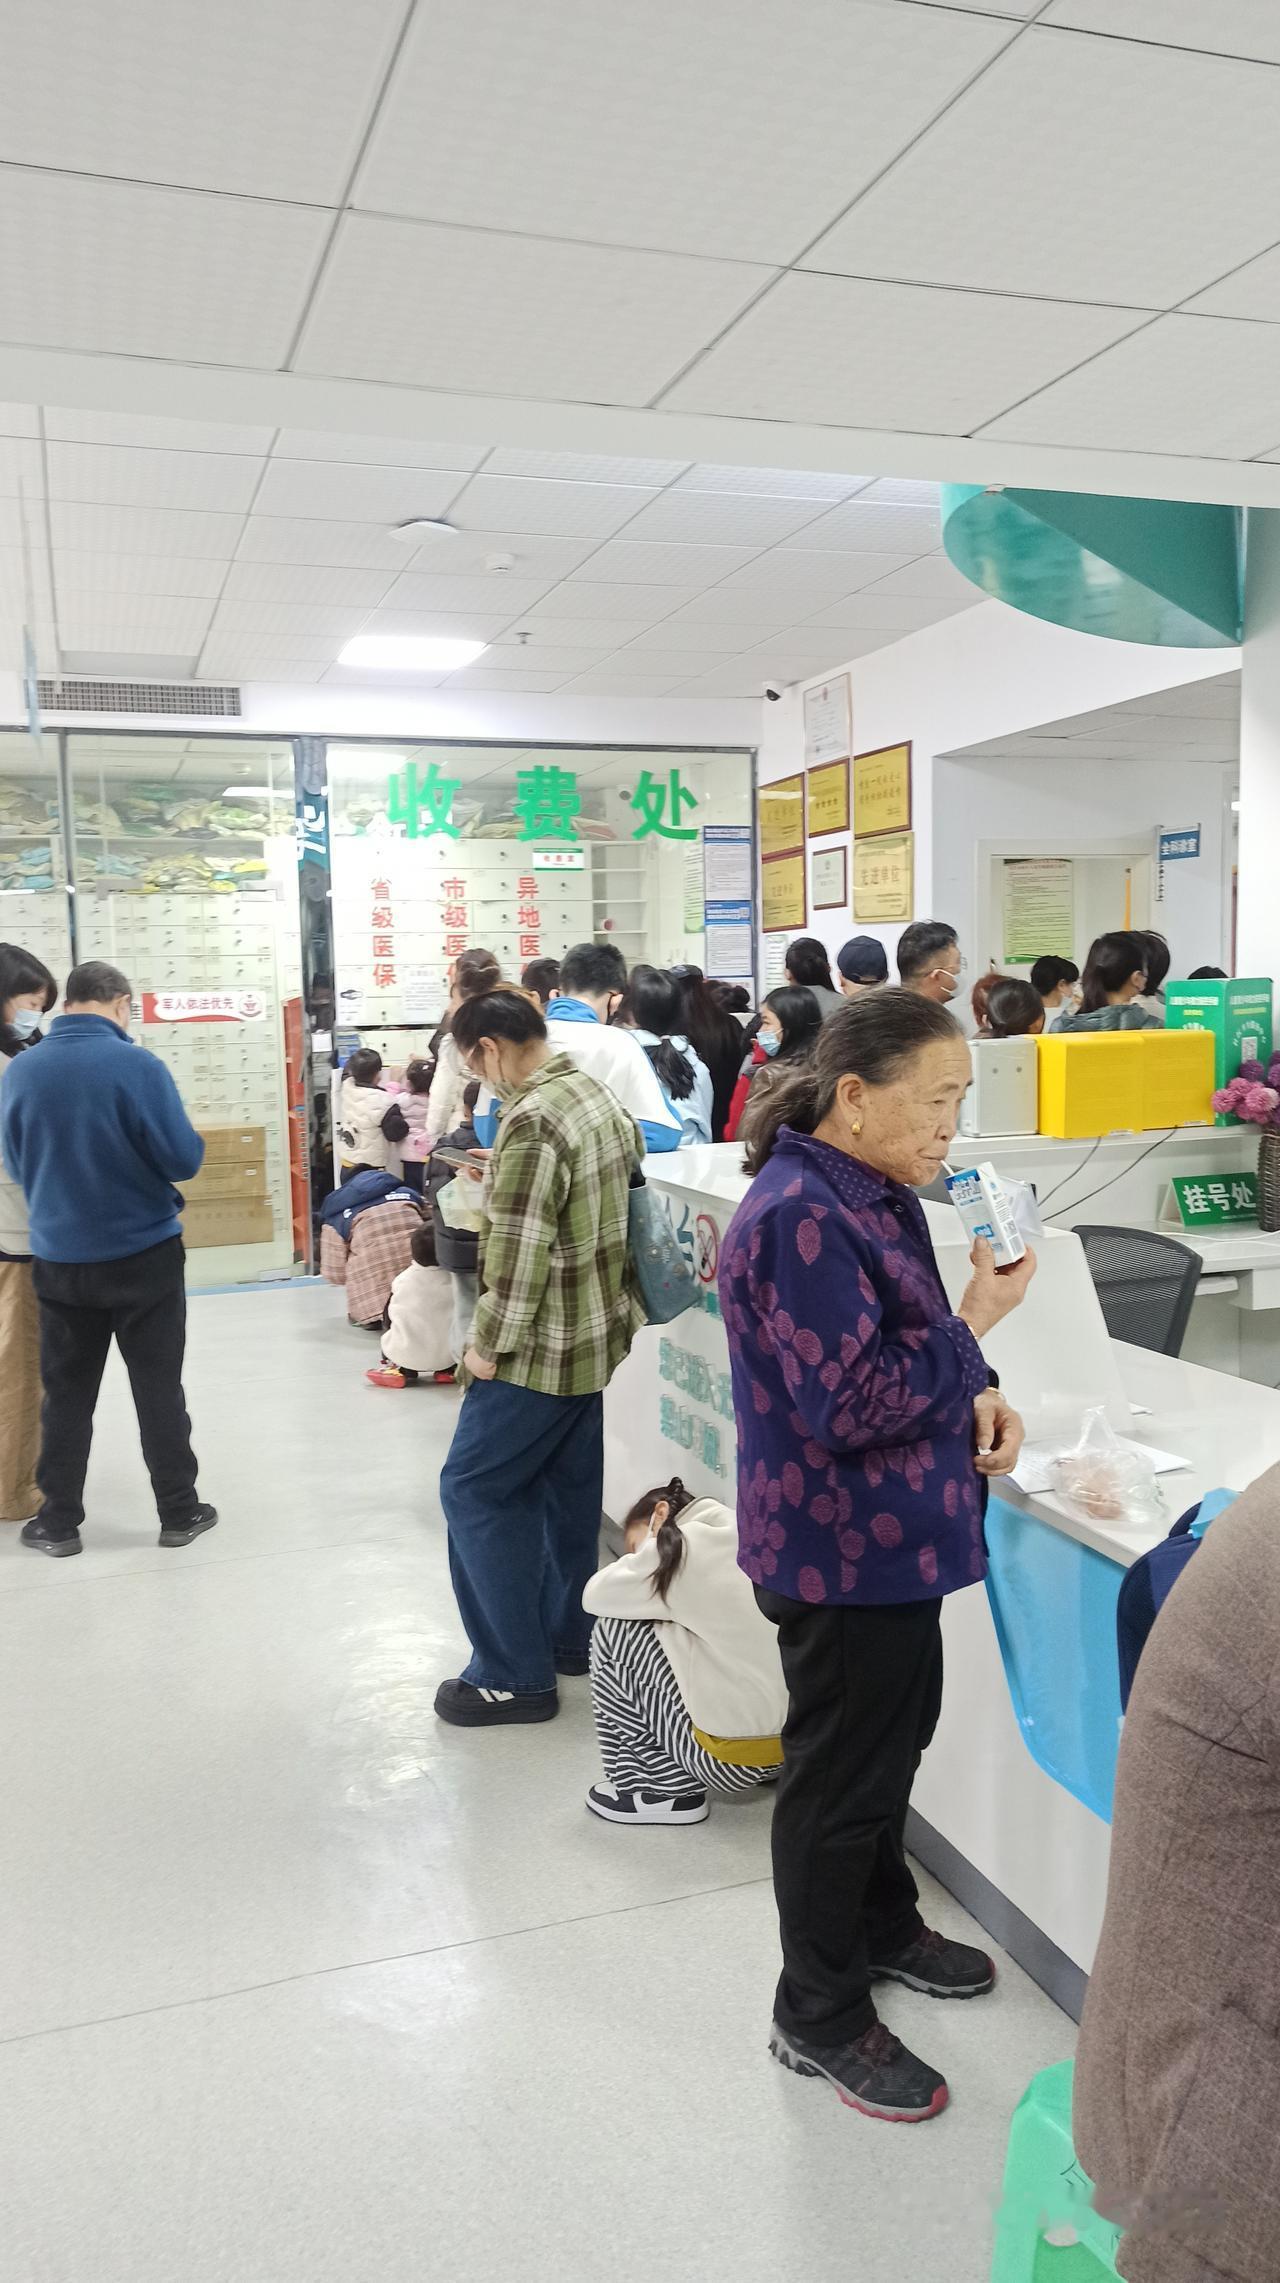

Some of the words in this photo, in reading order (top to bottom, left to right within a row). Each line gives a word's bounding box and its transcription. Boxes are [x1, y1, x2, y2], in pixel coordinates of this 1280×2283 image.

[387, 762, 700, 842] 收费处
[370, 877, 397, 988] 省级医保
[443, 877, 469, 984] 市级医
[517, 876, 542, 976] 异地医
[162, 997, 234, 1011] 军人依法优先
[1182, 1181, 1257, 1214] 挂号处
